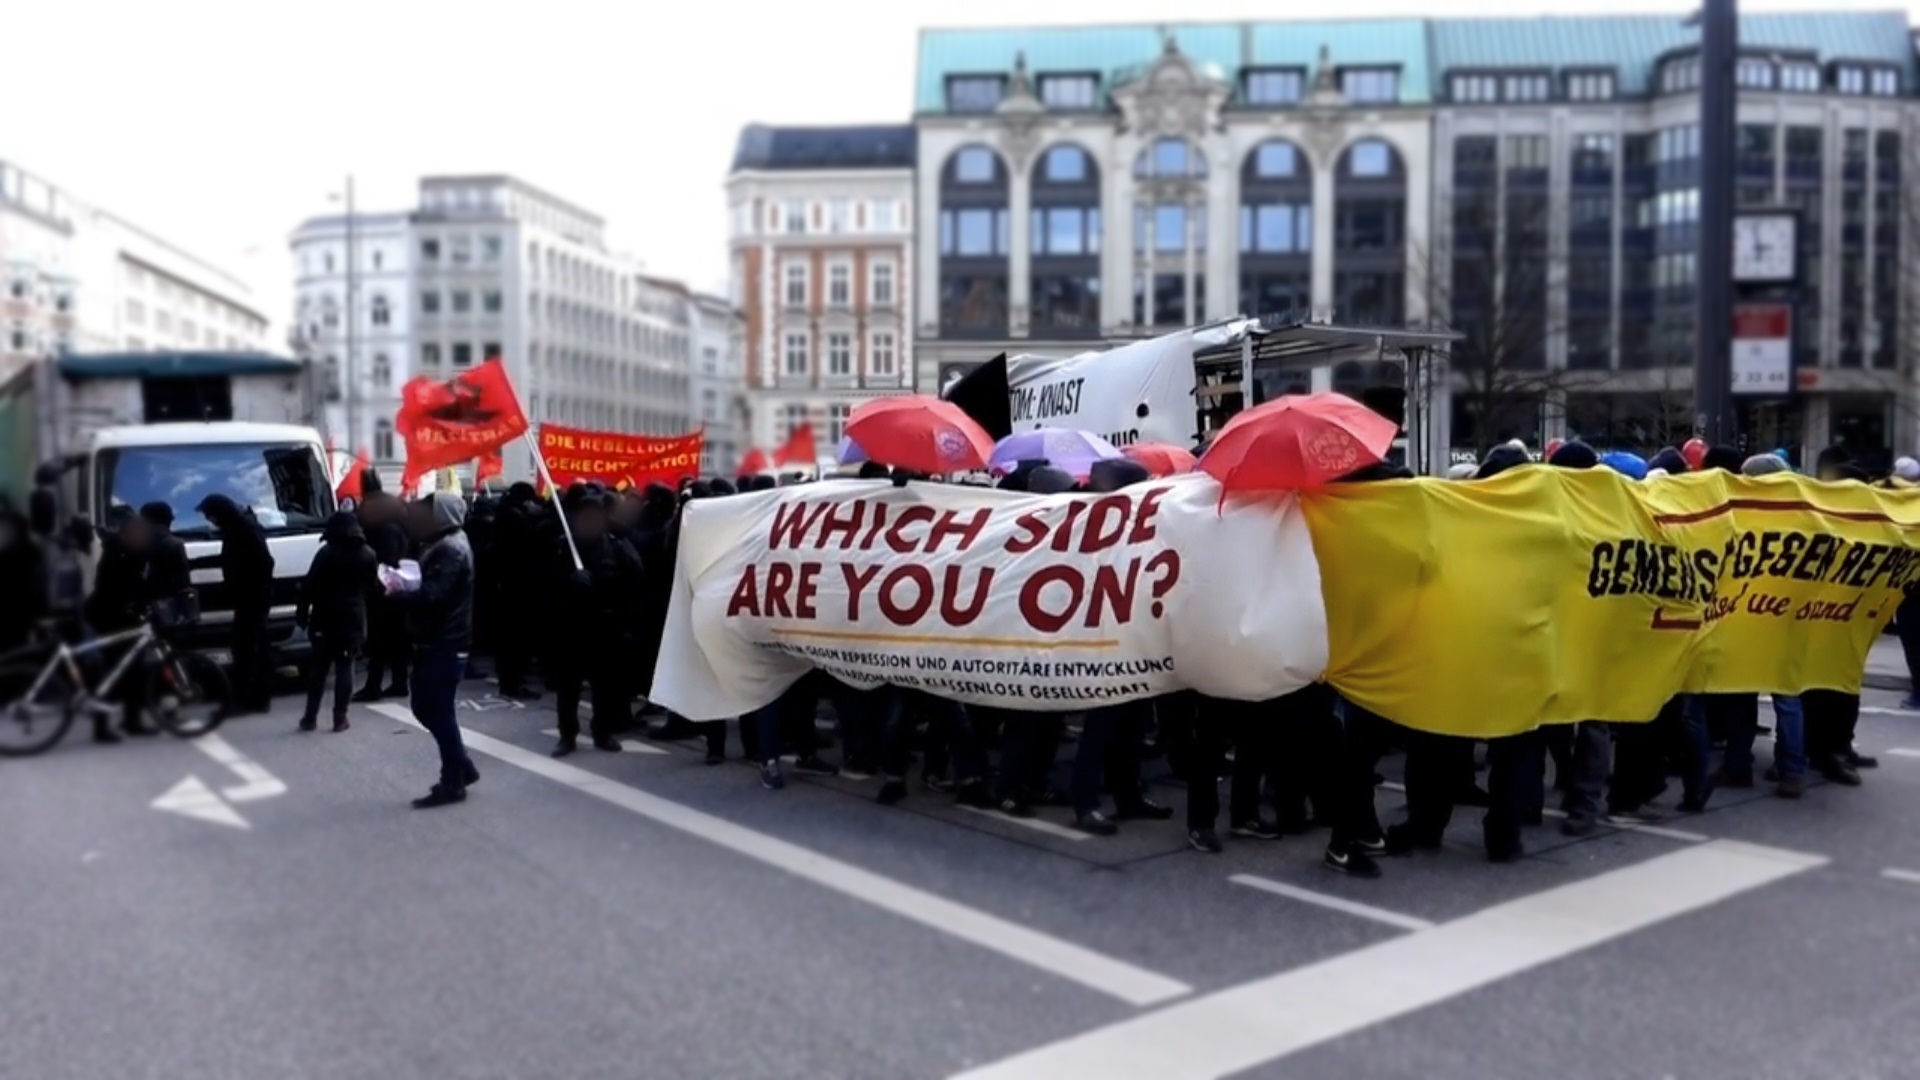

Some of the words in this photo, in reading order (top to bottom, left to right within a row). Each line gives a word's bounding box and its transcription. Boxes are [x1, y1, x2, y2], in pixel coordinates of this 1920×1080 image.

[1037, 378, 1084, 418] KNAST
[545, 434, 574, 449] DIE
[769, 499, 993, 553] WHICH
[1003, 486, 1174, 553] SIDE
[1732, 531, 1846, 582] GEGEN
[726, 562, 822, 619] ARE
[840, 563, 995, 626] YOU
[1019, 548, 1180, 633] ON?
[1748, 594, 1791, 616] we
[842, 650, 911, 669] REPRESSION
[916, 656, 947, 671] UND
[952, 655, 1050, 678] AUTORITÄRE
[1055, 656, 1174, 678] ENTWICKLUNG
[1030, 682, 1150, 700] GESELLSCHAFT
